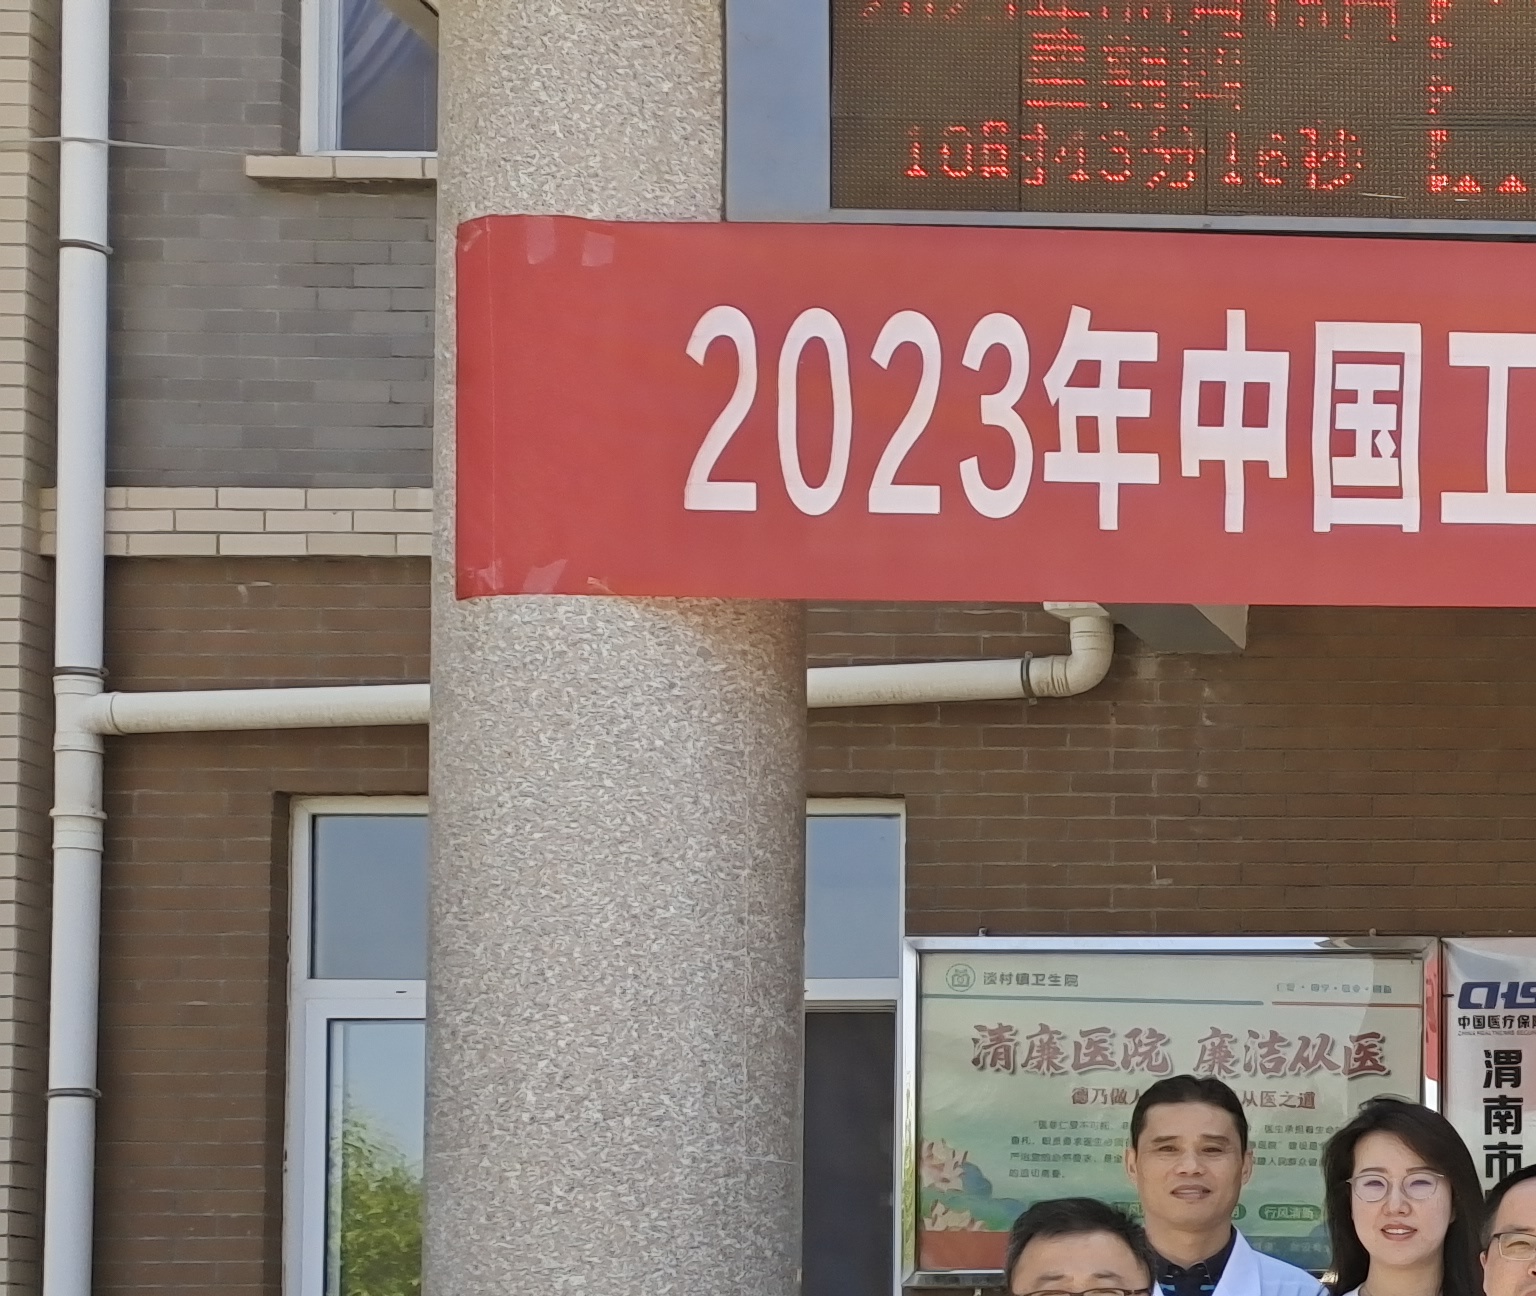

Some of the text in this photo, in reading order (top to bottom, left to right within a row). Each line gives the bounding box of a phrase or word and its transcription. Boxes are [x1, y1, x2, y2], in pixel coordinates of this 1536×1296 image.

[903, 119, 1363, 191] 10时43分16秒
[969, 1023, 1392, 1079] 清廉医院 廉洁从医
[1482, 1049, 1524, 1192] 渭南市
